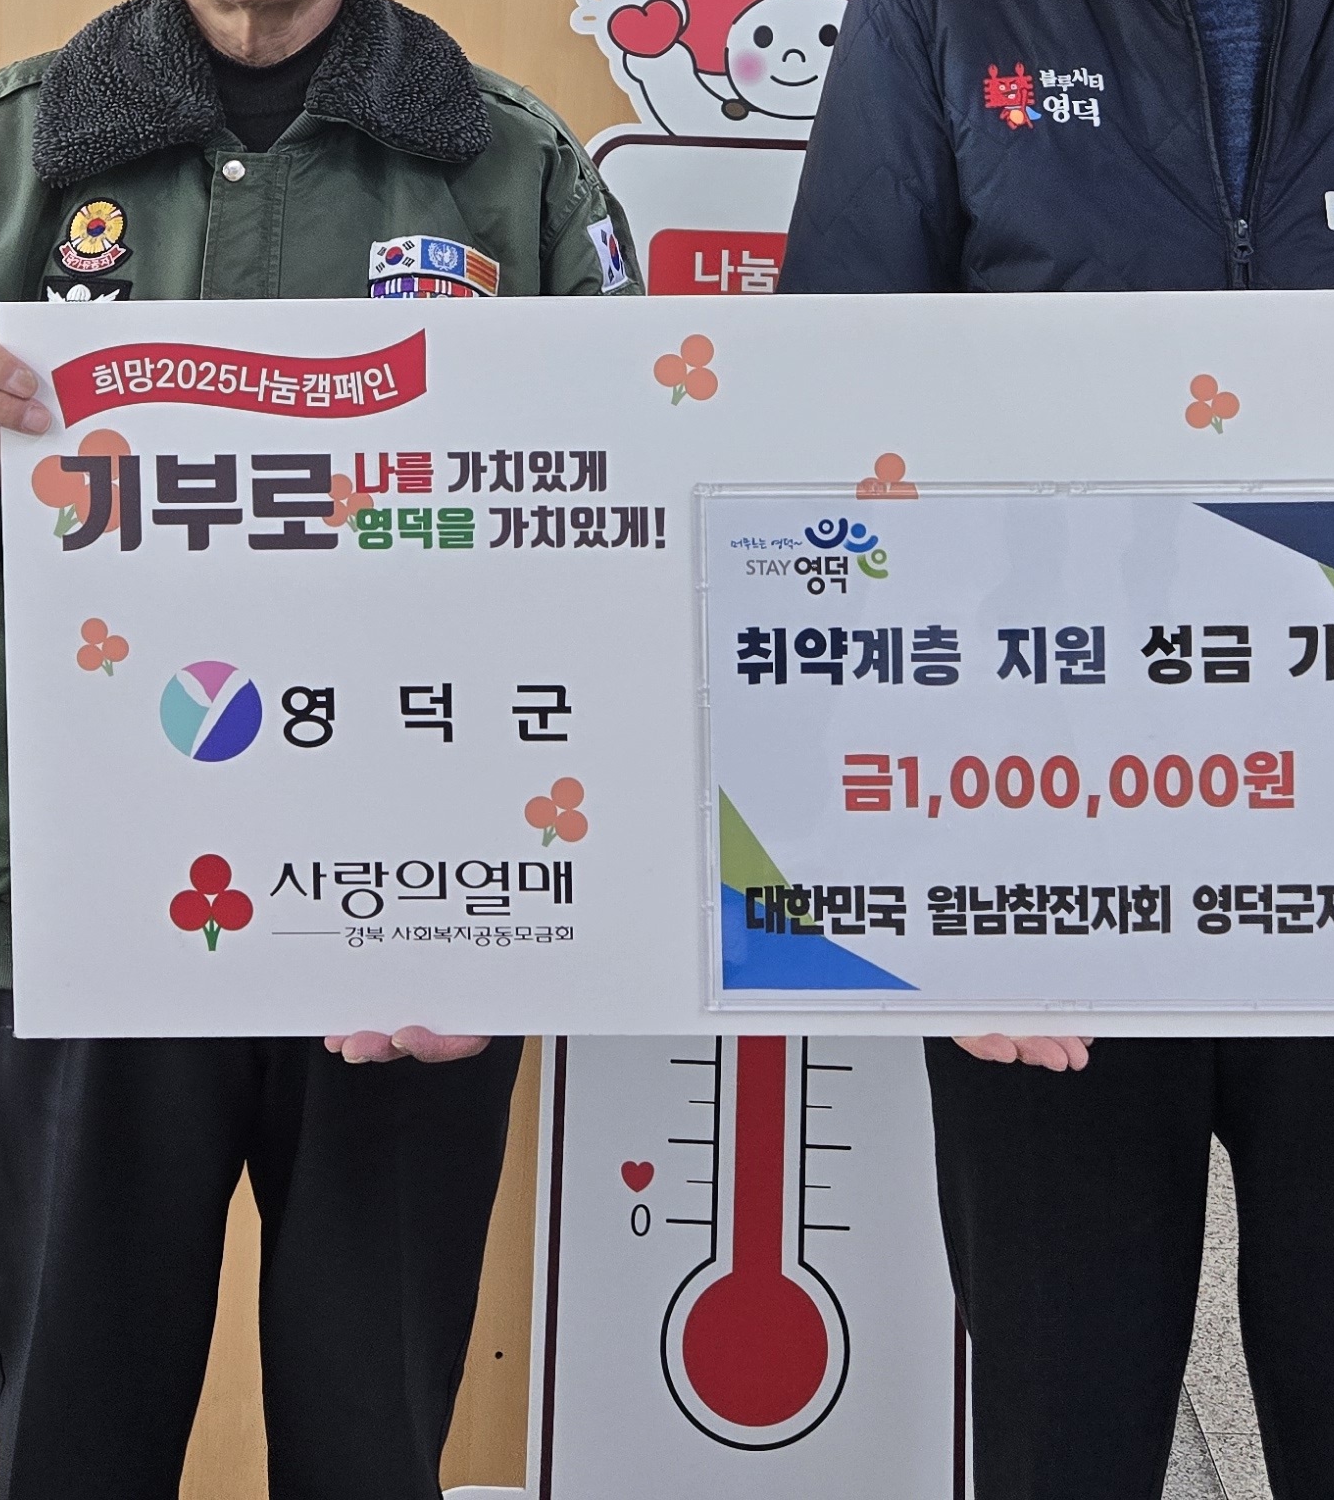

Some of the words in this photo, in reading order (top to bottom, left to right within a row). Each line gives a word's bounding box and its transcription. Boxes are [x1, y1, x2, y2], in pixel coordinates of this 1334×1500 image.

[1039, 67, 1105, 92] 블루시티
[1042, 93, 1101, 127] 영덕
[694, 249, 779, 293] 나눔
[92, 357, 399, 406] 희망2025나눔캠페인
[355, 451, 435, 494] 나를
[447, 449, 607, 493] 가치있게
[60, 453, 339, 552] 기부로
[355, 507, 476, 549] 영덕을
[488, 505, 666, 549] 가치있게!
[746, 559, 792, 576] STAY
[794, 556, 849, 596] 영덕
[736, 625, 962, 686] 취약계층
[997, 626, 1107, 685] 지원
[1140, 625, 1253, 685] 성금
[842, 751, 1295, 819] 금1,000,000원
[269, 860, 574, 920] 사랑의열매
[745, 884, 907, 936] 대한민국
[927, 884, 1172, 936] 월남참전자회
[345, 925, 385, 948] 경북
[391, 925, 575, 948] 사회복지공동모금회
[630, 1203, 652, 1237] 0
